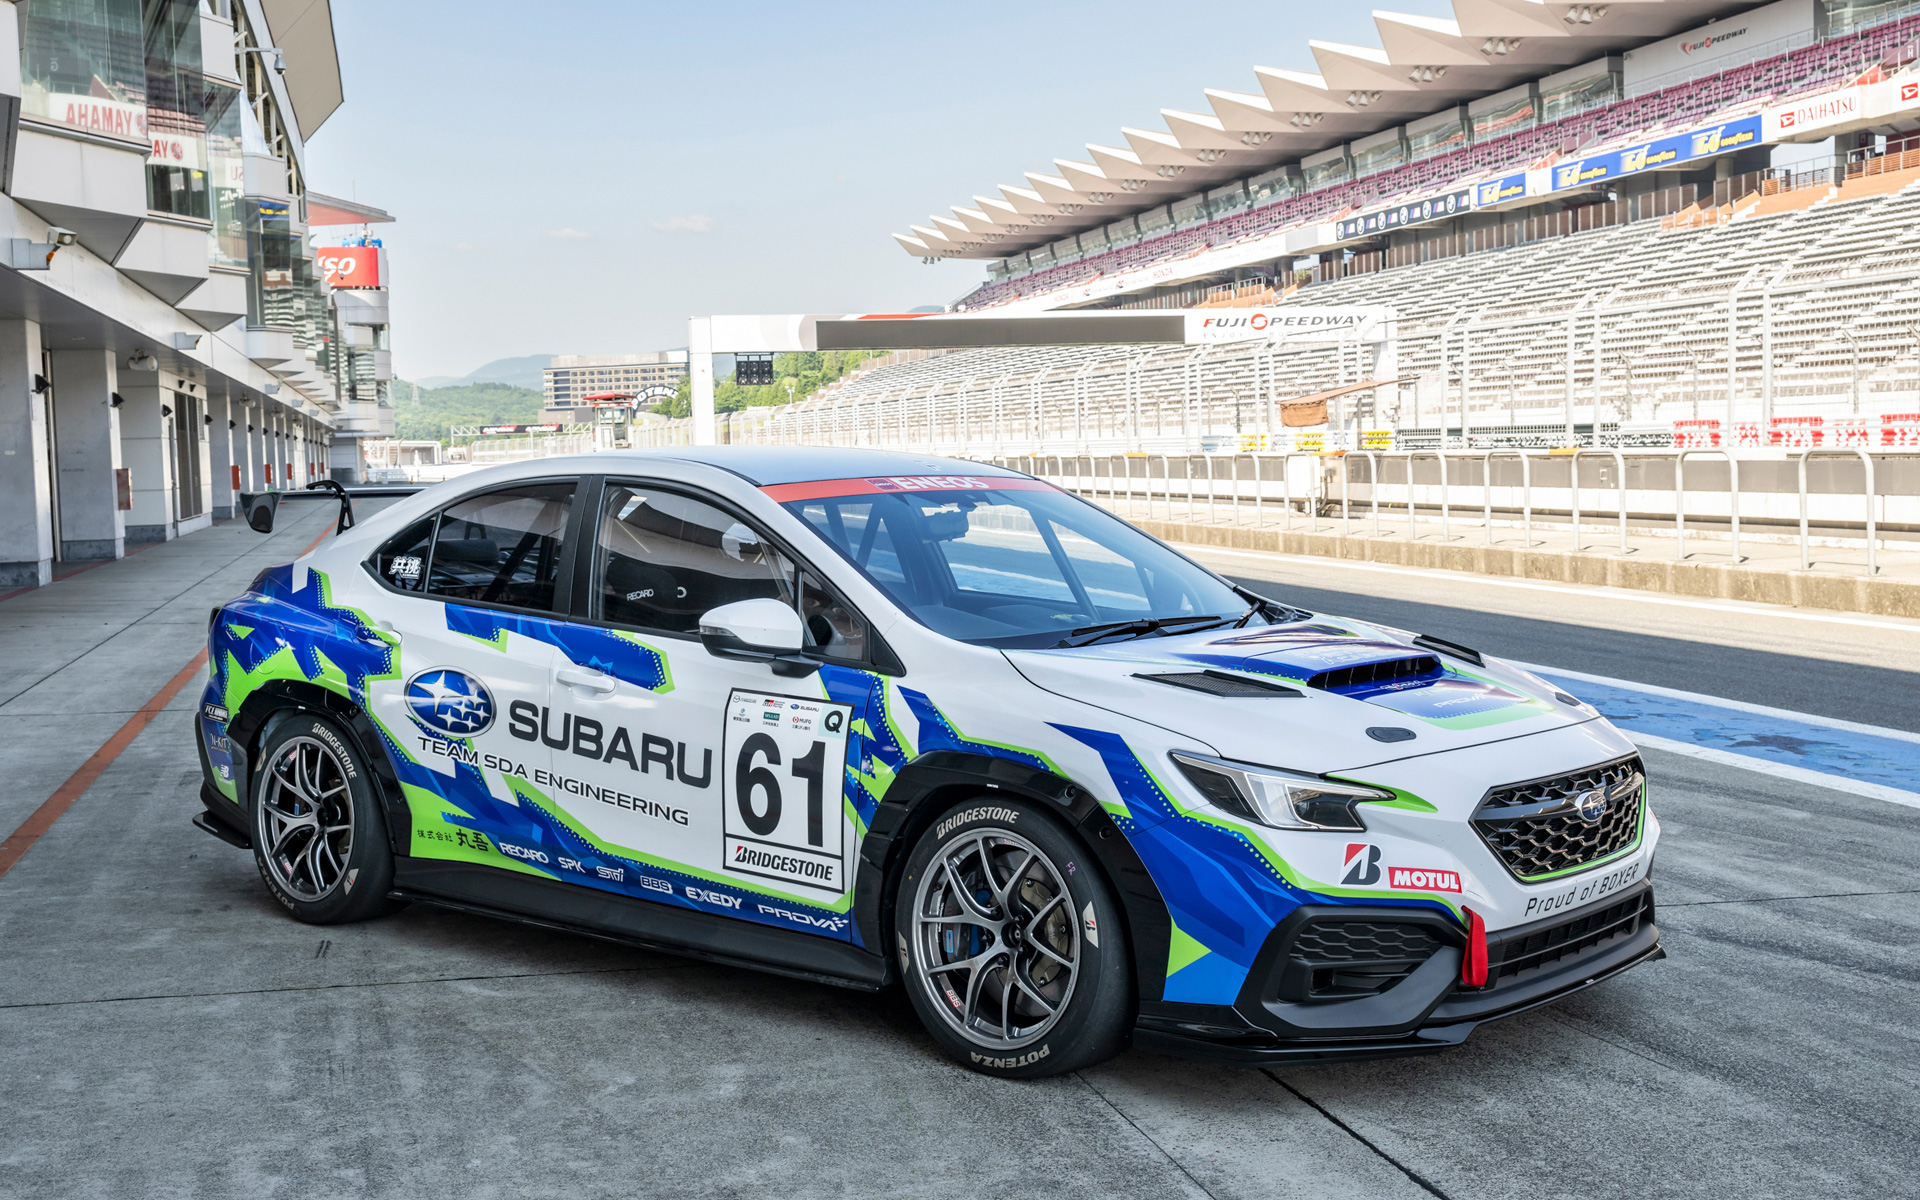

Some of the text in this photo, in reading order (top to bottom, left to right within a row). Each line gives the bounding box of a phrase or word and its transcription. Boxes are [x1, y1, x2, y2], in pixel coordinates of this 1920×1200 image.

[1798, 96, 1856, 124] DAIHATSU
[1203, 318, 1248, 327] FUJI
[889, 476, 990, 490] ENEOS
[626, 588, 654, 601] RECARO
[824, 710, 843, 733] Q
[312, 722, 357, 778] BRIDGESTONE
[509, 699, 712, 789] SUBARU
[417, 736, 689, 826] TEAM SDA ENGINEERING
[736, 732, 826, 848] 61
[936, 807, 1020, 840] BRIDGESTONE
[417, 829, 453, 842] 株式会社
[456, 829, 489, 852] 丸吾
[499, 842, 549, 864] RECARO
[734, 845, 833, 881] BRIDGESTONE
[558, 857, 585, 874] SPK
[1066, 861, 1076, 876] FR
[640, 875, 673, 894] BBS
[1393, 869, 1459, 890] MOTUL
[1524, 863, 1640, 917] Proud of BOXER
[685, 886, 742, 910] EXEDY
[757, 904, 842, 932] PROVA
[946, 989, 961, 1008] BBS
[970, 1044, 1050, 1069] POTENZA
